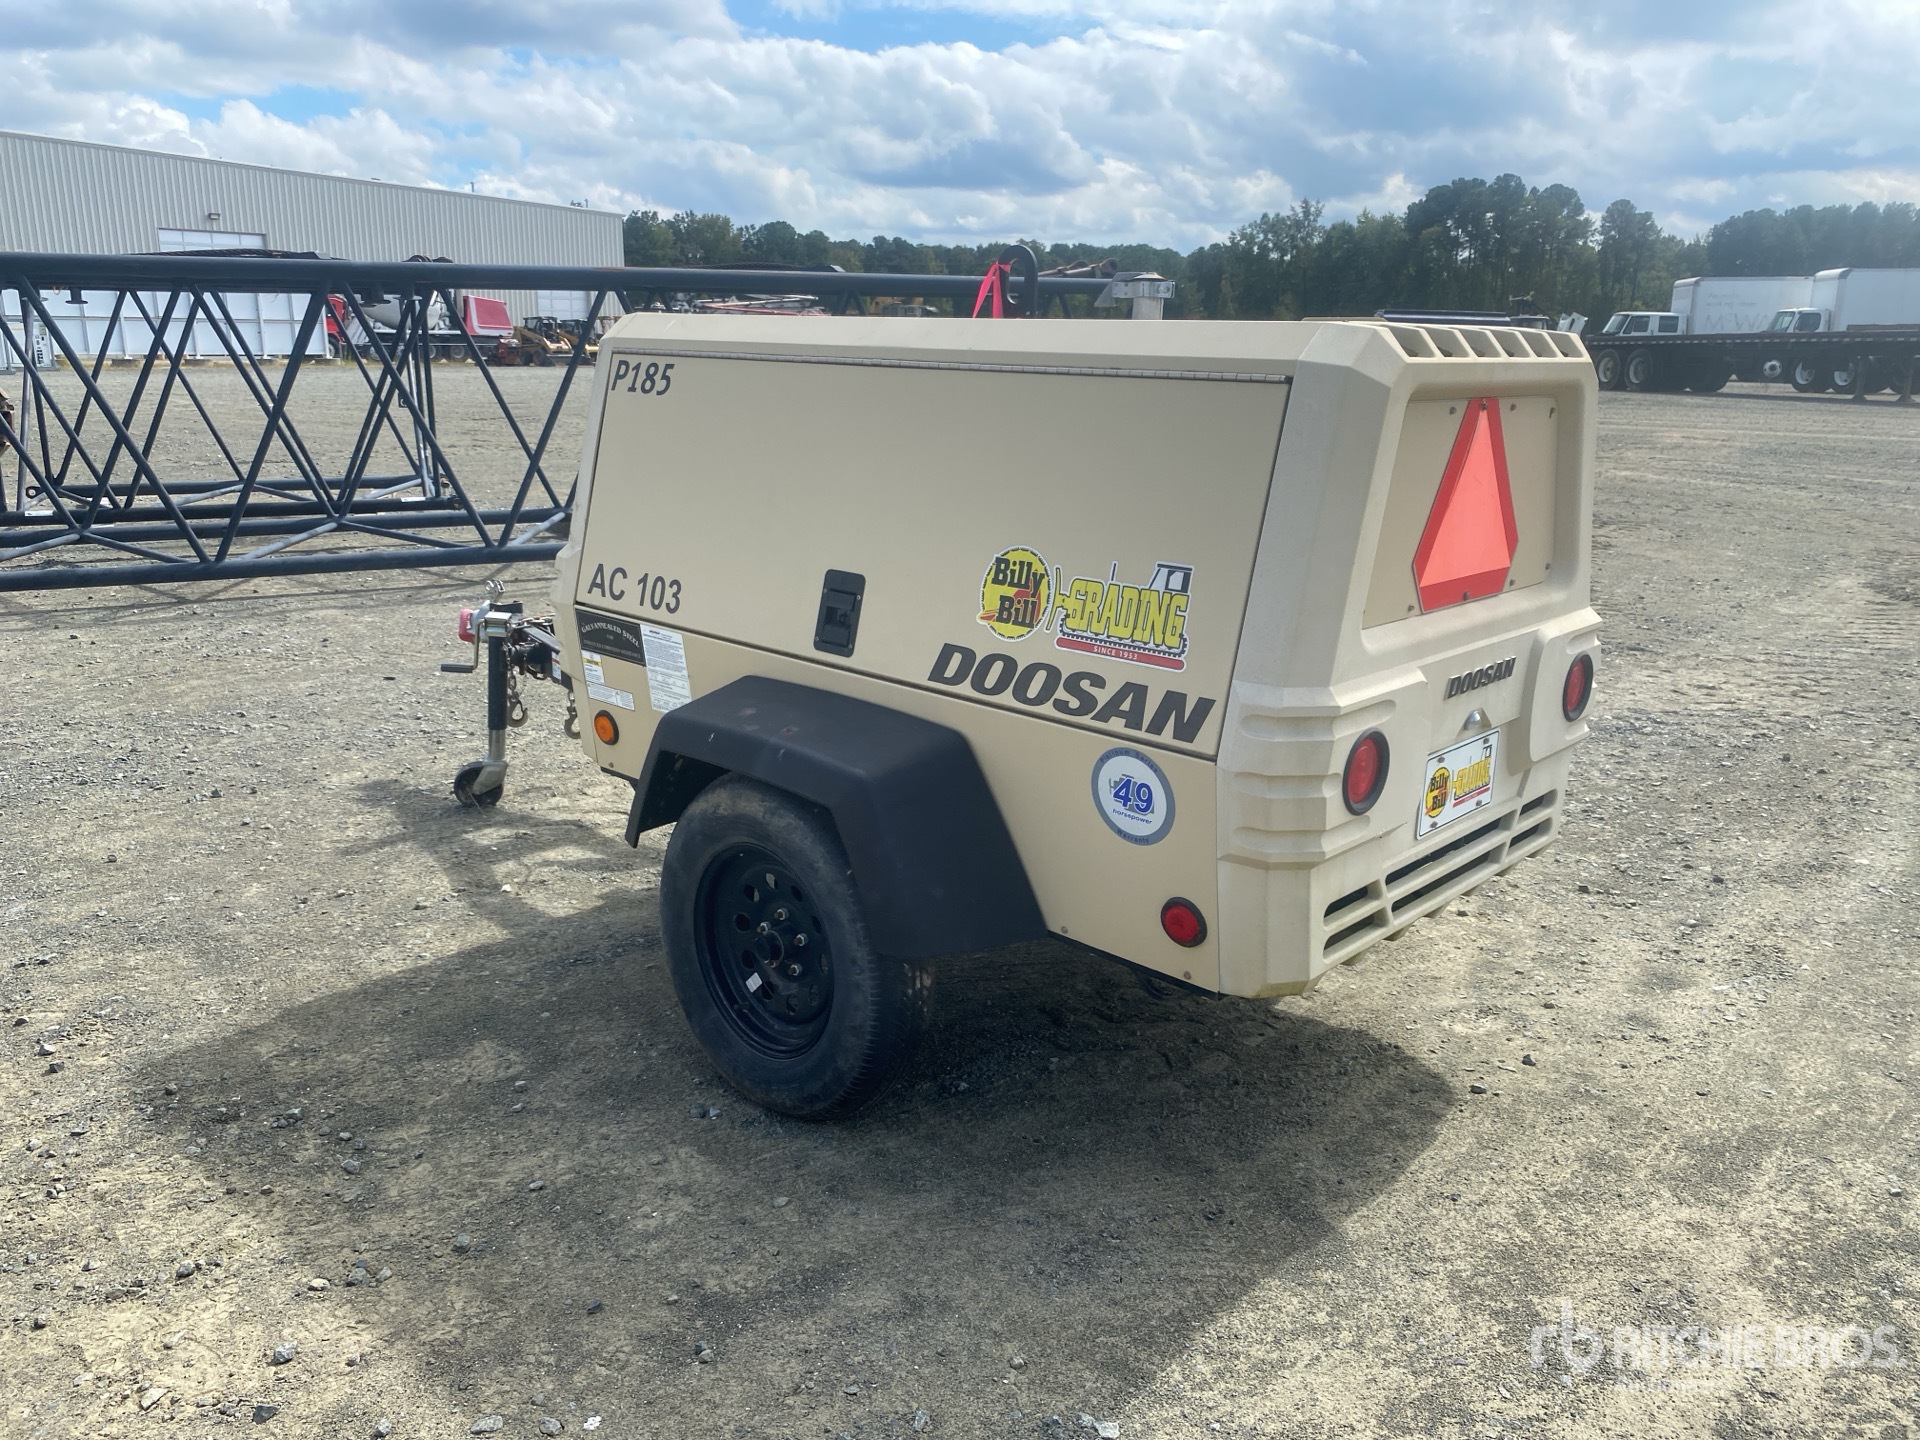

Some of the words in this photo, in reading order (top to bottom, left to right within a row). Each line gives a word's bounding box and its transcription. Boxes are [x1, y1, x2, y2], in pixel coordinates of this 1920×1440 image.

[611, 360, 675, 396] P185
[587, 563, 628, 602] AC
[637, 573, 682, 614] 103
[991, 556, 1046, 599] Billy
[995, 595, 1038, 629] Bill
[1066, 578, 1188, 649] GRADING
[1093, 645, 1117, 657] SINCE
[1118, 650, 1139, 660] 1953
[927, 643, 1216, 744] DOOSAN
[1446, 656, 1517, 697] DOOSAN
[1112, 778, 1154, 815] 49
[1429, 772, 1450, 793] Billy
[1431, 791, 1447, 810] Bill
[1112, 808, 1153, 825] horsepower
